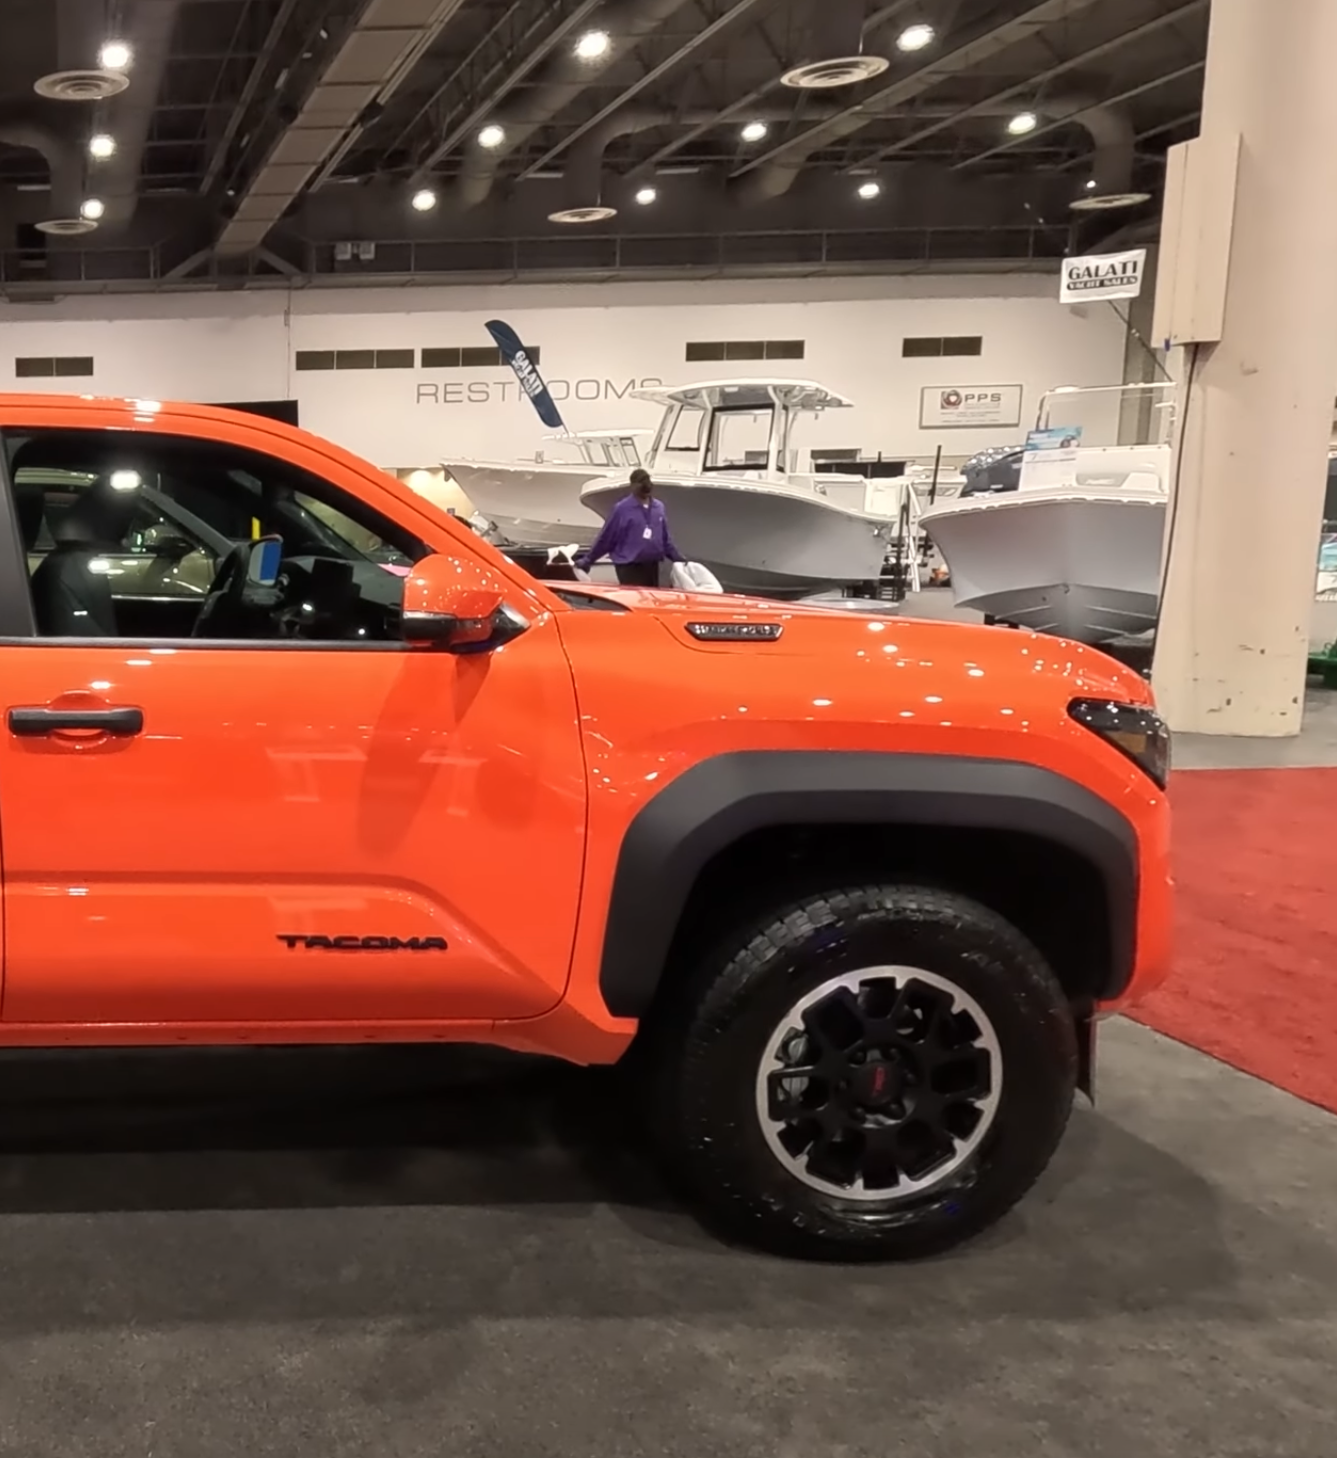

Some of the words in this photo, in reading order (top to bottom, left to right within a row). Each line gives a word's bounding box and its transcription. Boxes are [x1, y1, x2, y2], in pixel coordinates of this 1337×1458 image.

[1068, 261, 1138, 280] GALATI
[515, 350, 544, 396] GALATI
[964, 393, 1002, 403] PPS
[275, 934, 448, 951] TACOMA
